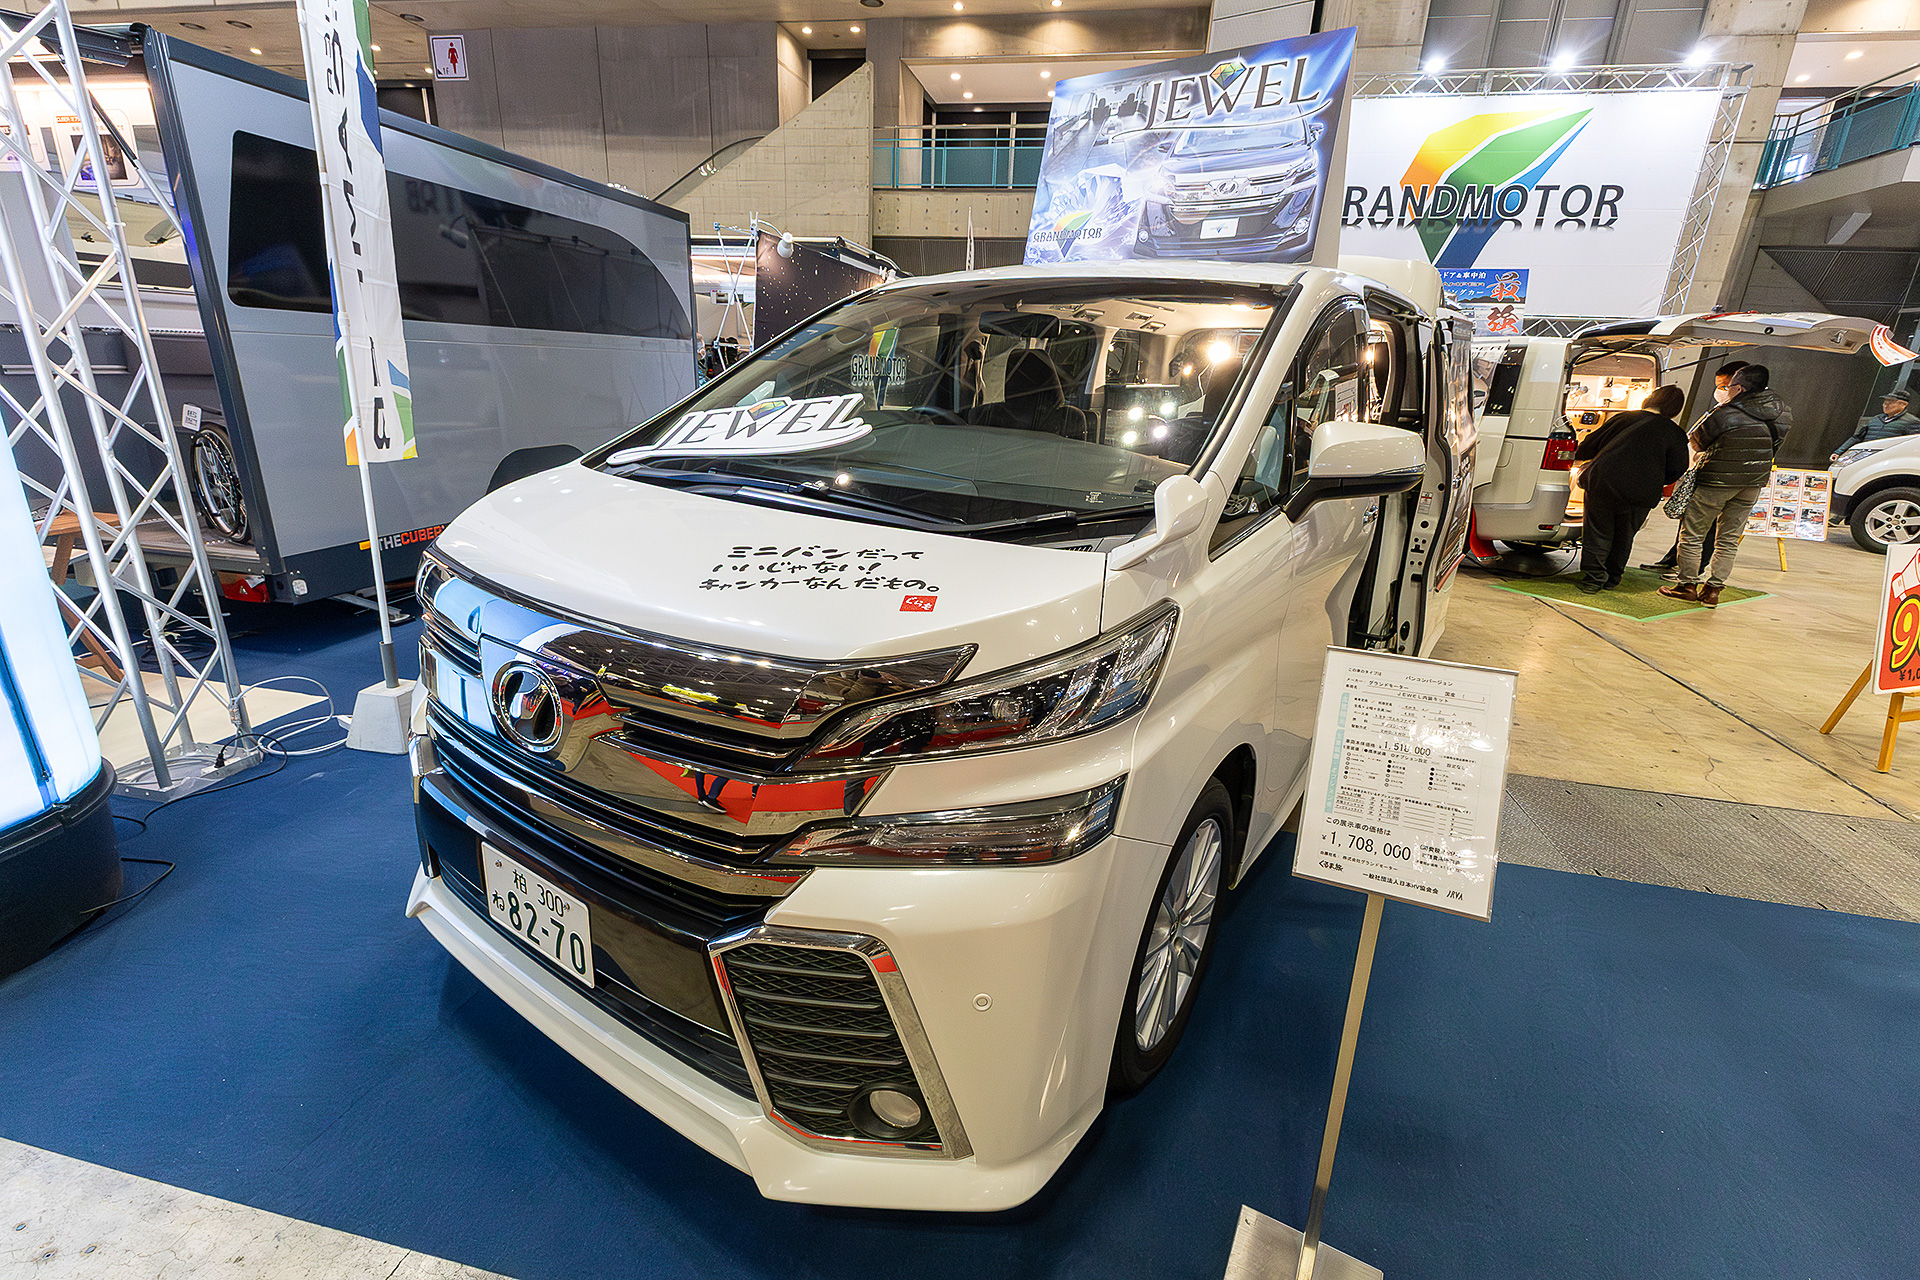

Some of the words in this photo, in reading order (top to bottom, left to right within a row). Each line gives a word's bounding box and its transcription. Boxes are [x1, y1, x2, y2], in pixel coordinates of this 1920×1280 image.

[1144, 57, 1320, 129] JEWEL
[1342, 184, 1625, 218] RANDMOTOR
[1033, 227, 1102, 243] GRANDMOTOR
[656, 396, 860, 450] JEWEL
[1890, 594, 1920, 673] 9
[1326, 816, 1392, 836] この展示車の価格は
[513, 868, 528, 896] 柏
[536, 883, 565, 918] 300
[491, 889, 506, 912] ね
[507, 890, 587, 976] 82-70
